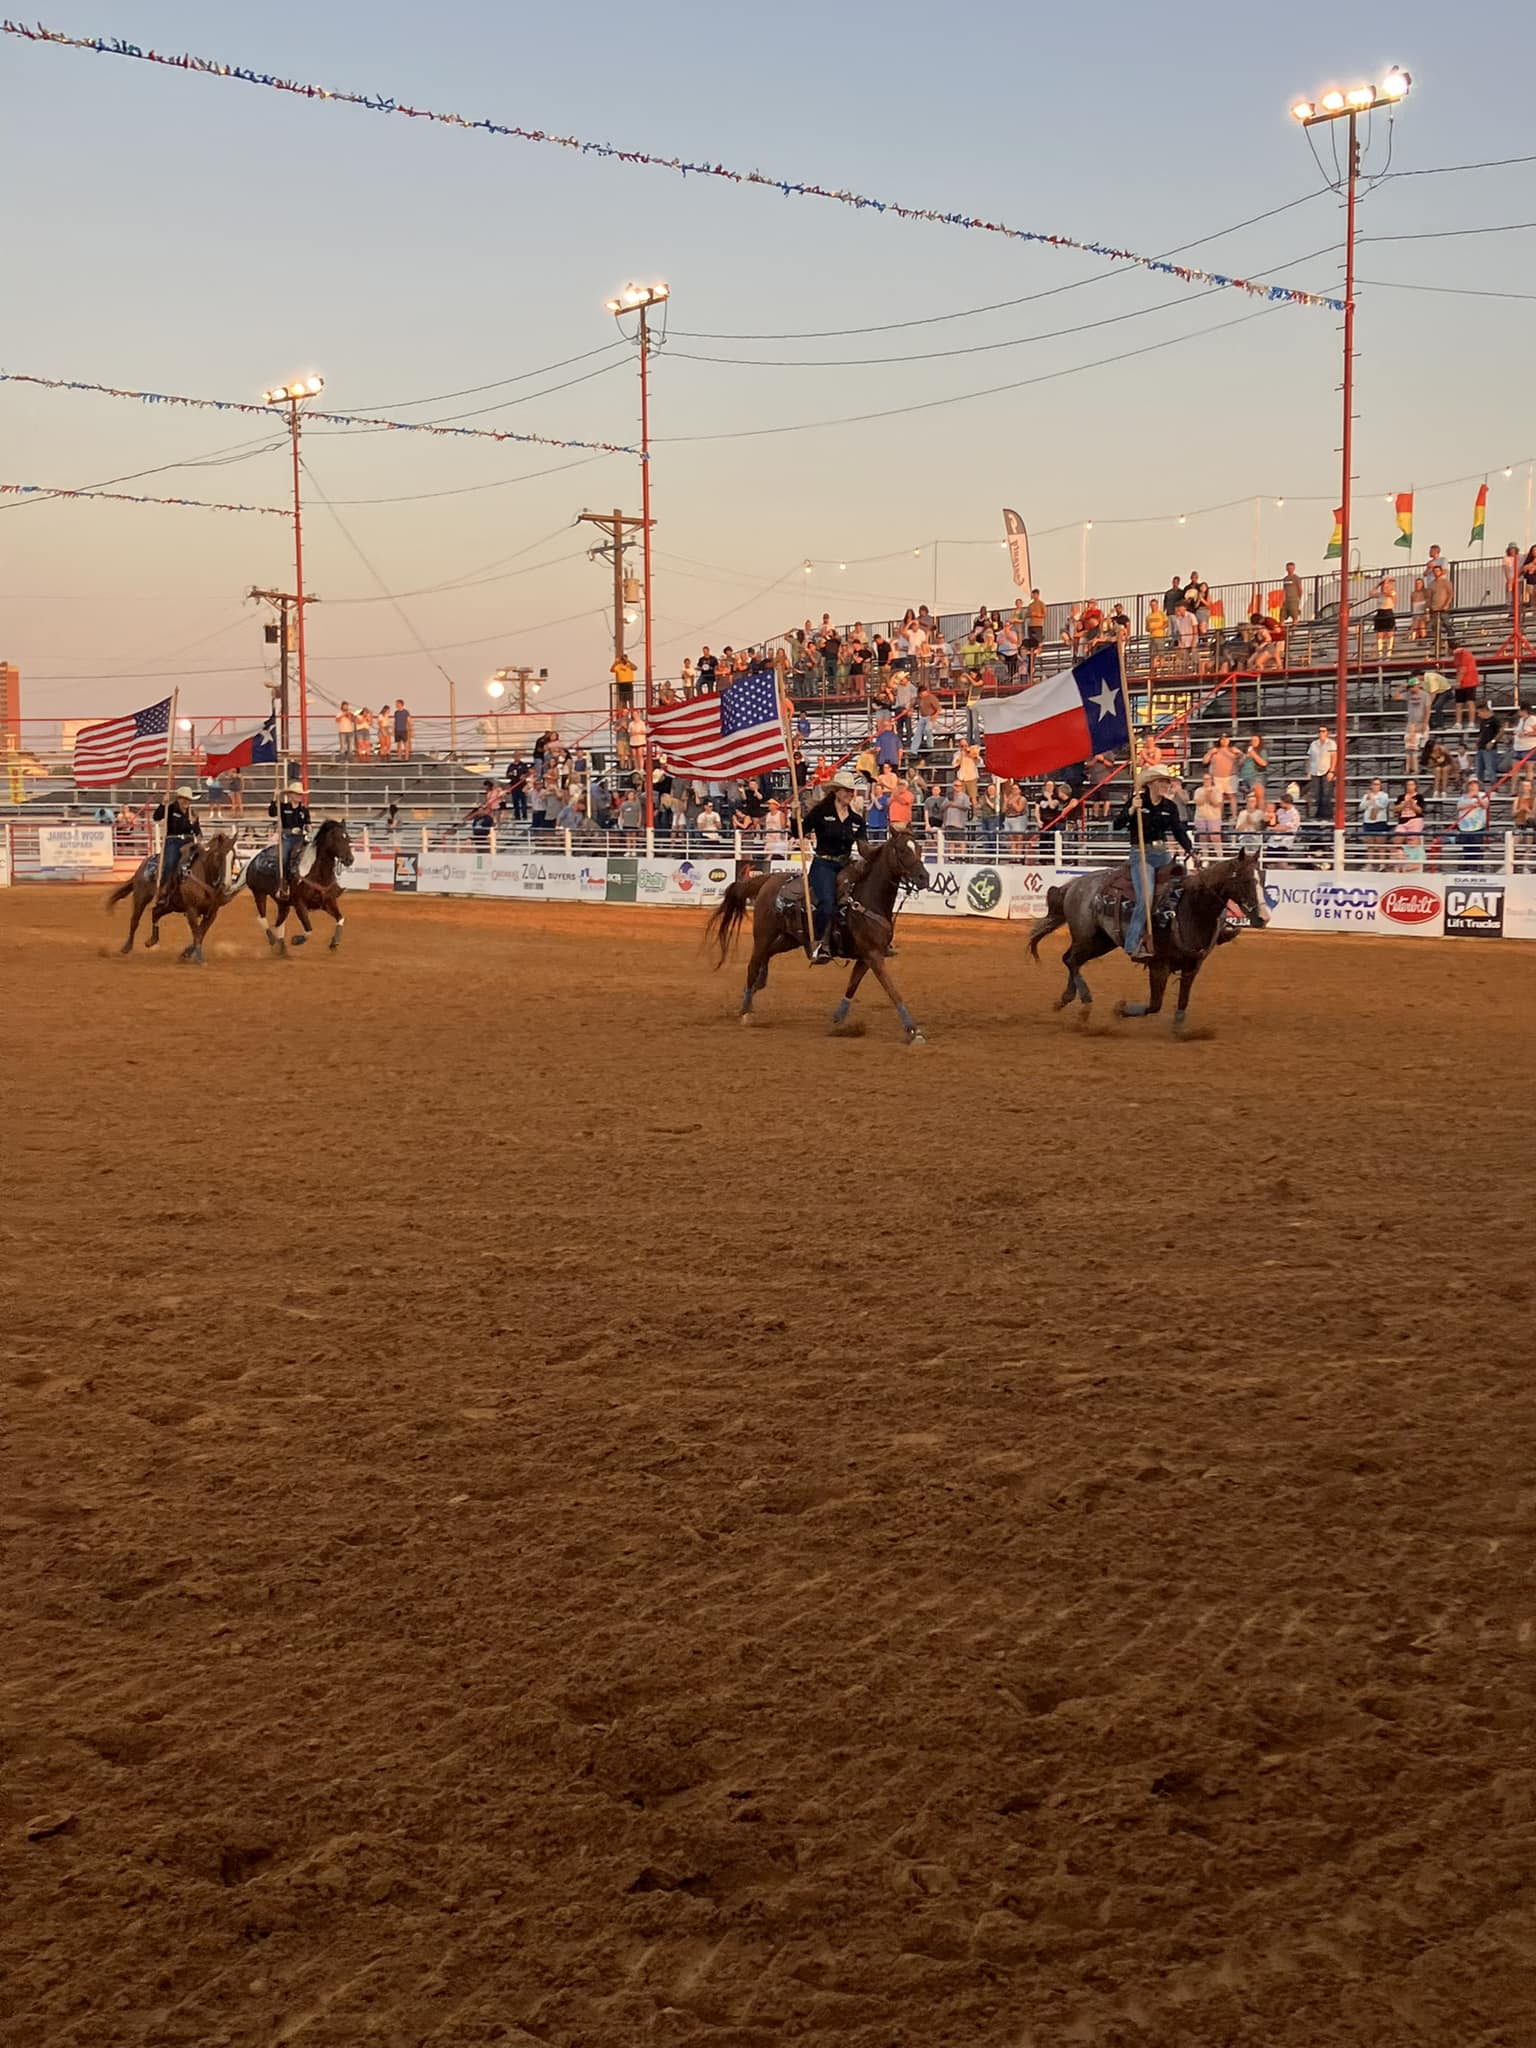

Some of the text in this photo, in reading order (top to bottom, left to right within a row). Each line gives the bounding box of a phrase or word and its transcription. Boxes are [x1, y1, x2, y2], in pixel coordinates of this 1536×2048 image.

[1315, 887, 1378, 908] WOOD
[1385, 893, 1438, 914] Peterbilt
[1447, 891, 1503, 917] CAT
[1314, 908, 1376, 920] DENTON
[1447, 919, 1501, 929] Lift Trucks
